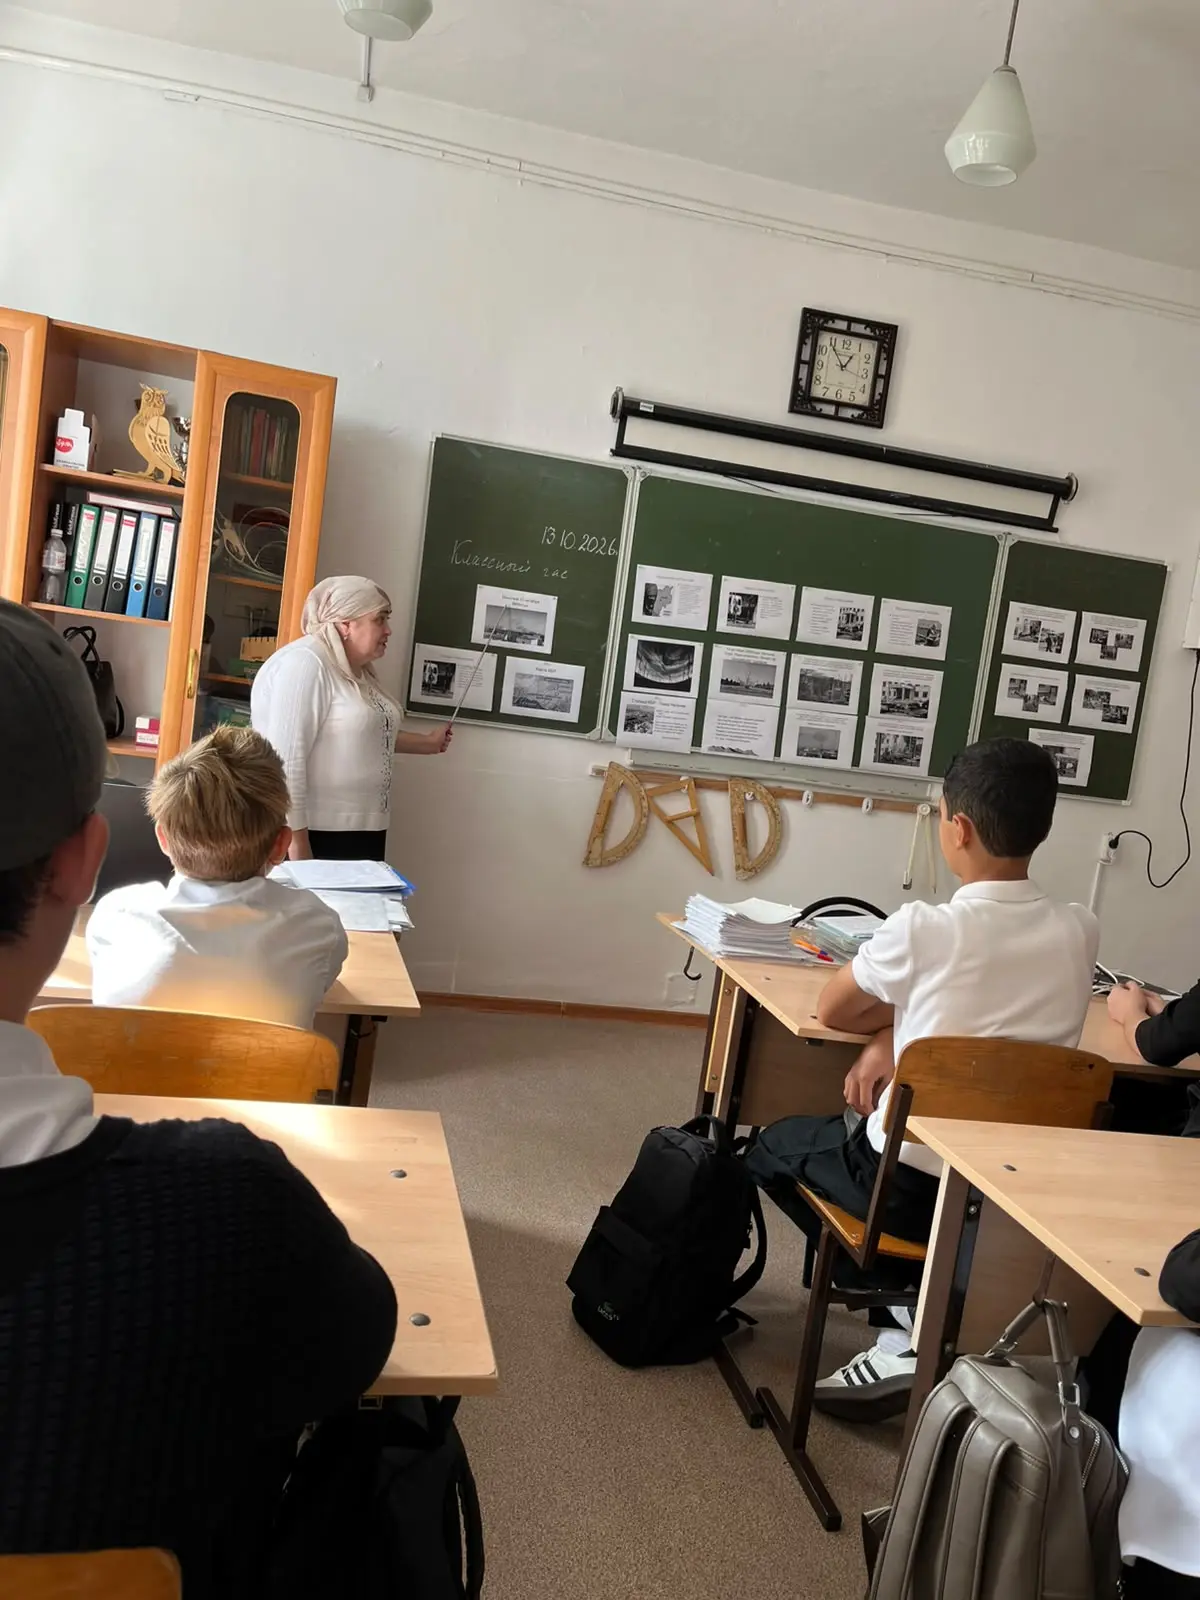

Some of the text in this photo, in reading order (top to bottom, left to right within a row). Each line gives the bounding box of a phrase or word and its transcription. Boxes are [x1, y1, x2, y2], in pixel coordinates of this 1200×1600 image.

[842, 338, 852, 350] 12
[818, 345, 828, 356] 10
[864, 354, 870, 364] 2
[816, 360, 824, 370] 9
[861, 368, 868, 380] 3
[814, 374, 822, 386] 8
[822, 386, 829, 396] 7
[859, 384, 866, 394] 4
[836, 389, 842, 400] 6
[848, 392, 856, 402] 5
